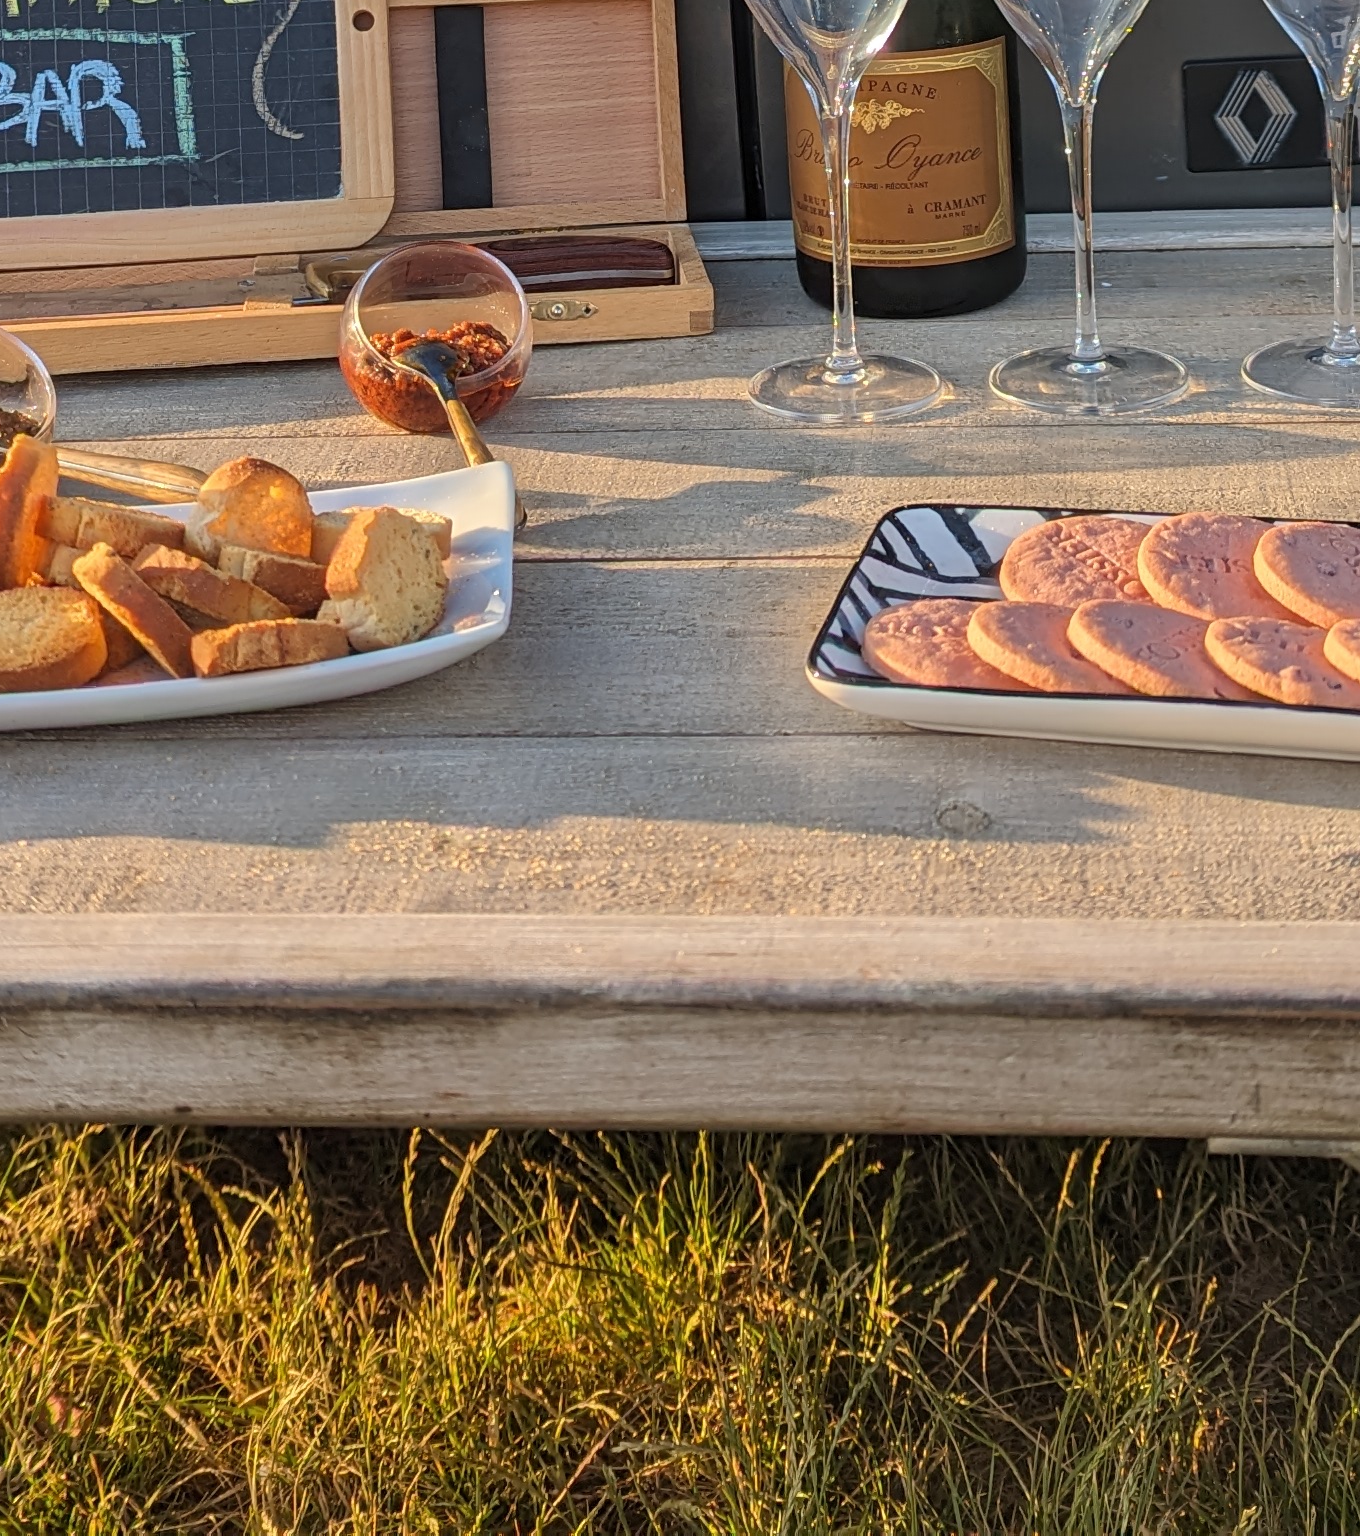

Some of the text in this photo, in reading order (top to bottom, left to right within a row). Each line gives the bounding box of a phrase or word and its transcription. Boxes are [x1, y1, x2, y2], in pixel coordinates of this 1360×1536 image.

[794, 128, 983, 182] Bruo Oyance
[803, 193, 827, 207] BRUT
[925, 194, 988, 214] CRAMANT
[935, 210, 966, 219] MARNE
